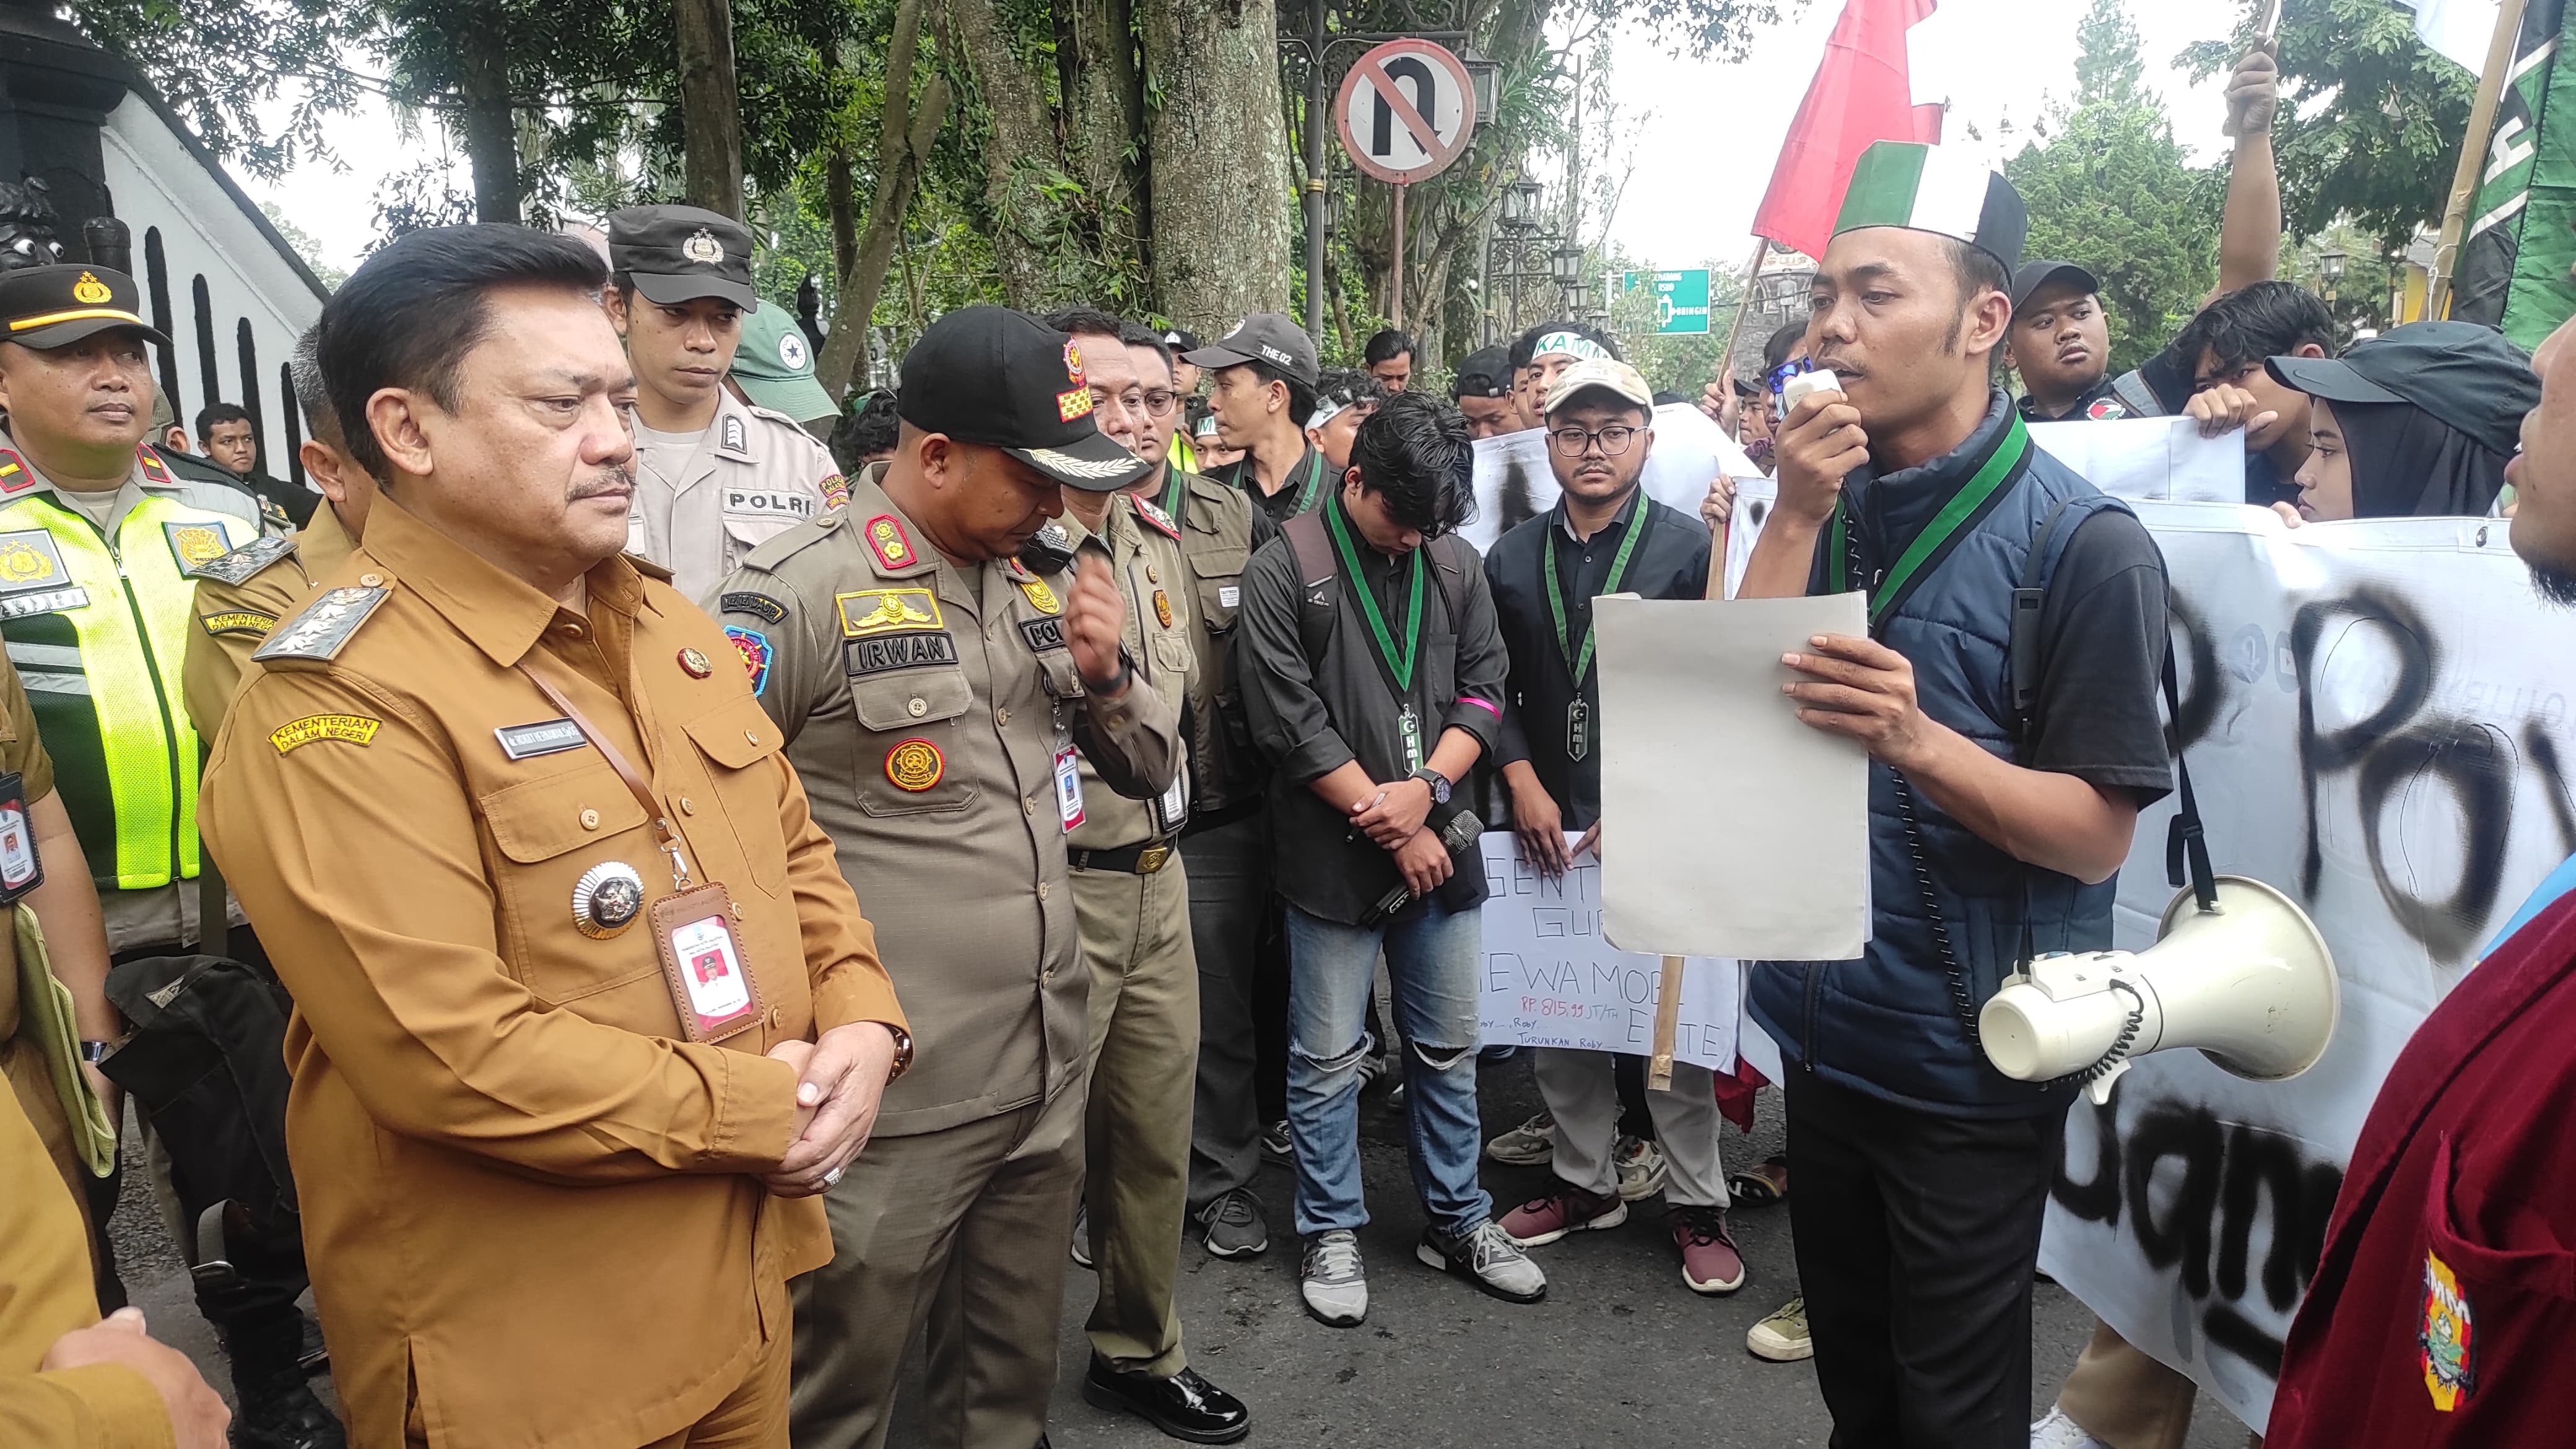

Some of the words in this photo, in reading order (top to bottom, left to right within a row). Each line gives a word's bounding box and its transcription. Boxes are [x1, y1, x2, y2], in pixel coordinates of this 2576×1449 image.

[1261, 345, 1280, 361] THE
[730, 493, 810, 515] POLRI
[212, 621, 247, 631] DALAM
[214, 613, 276, 625] KEMENTERIA
[859, 637, 944, 669] IRWAN
[276, 718, 373, 741] KEMENTERIAN
[281, 729, 320, 749] DALAM
[326, 727, 367, 741] NEGERI
[1481, 952, 1580, 994] EWA
